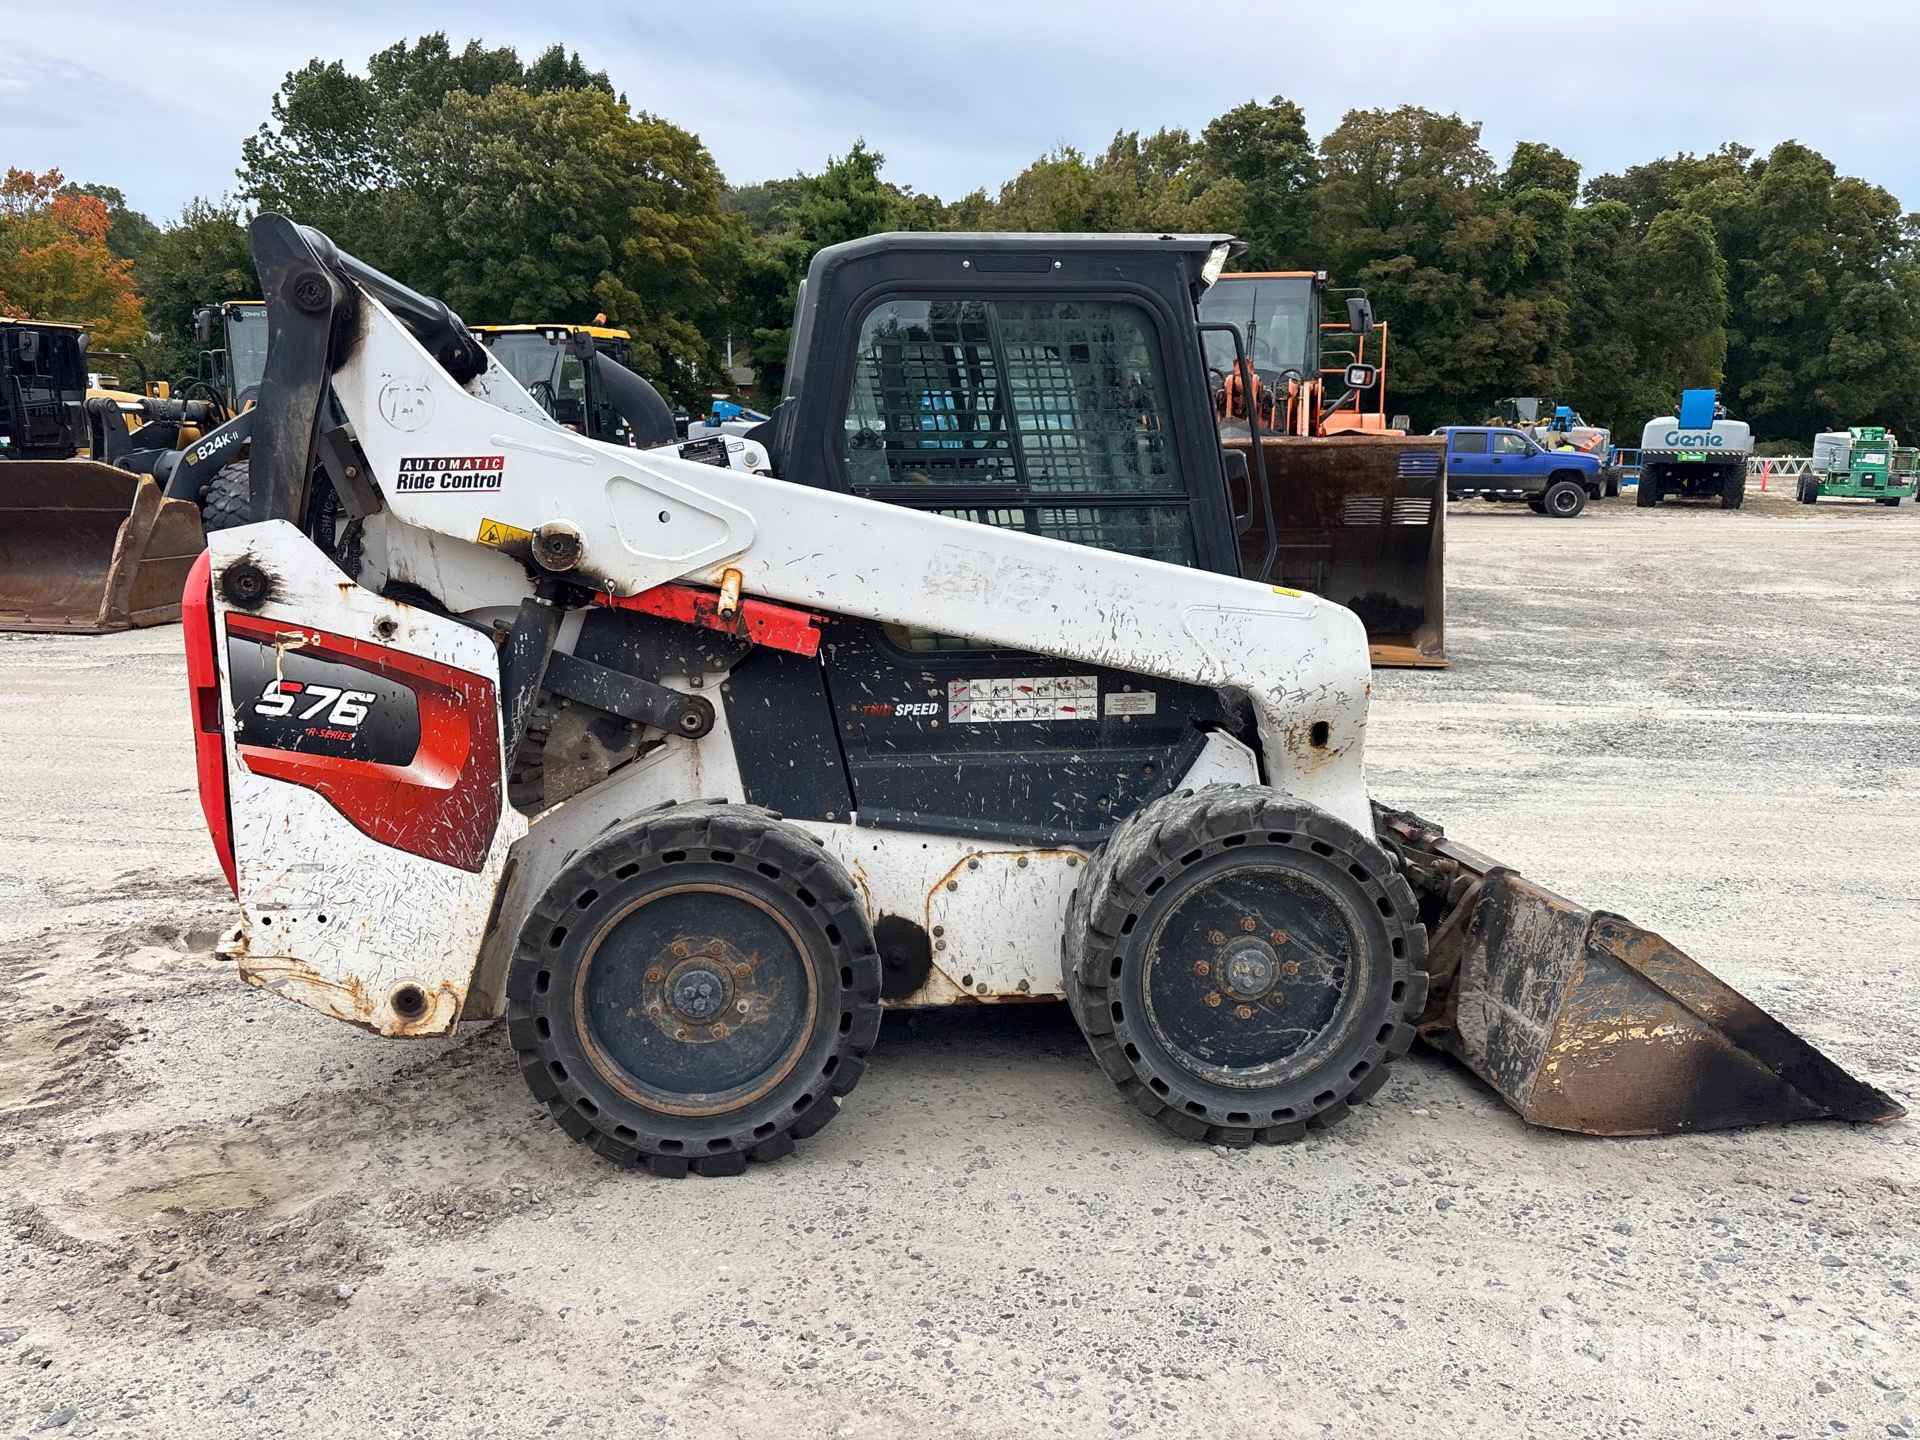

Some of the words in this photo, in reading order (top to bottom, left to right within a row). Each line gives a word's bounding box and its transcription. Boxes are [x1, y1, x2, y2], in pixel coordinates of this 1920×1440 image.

[1664, 430, 1723, 447] Genie
[403, 458, 501, 470] AUTOMATIC
[396, 473, 435, 490] Ride
[440, 472, 502, 489] Control
[254, 679, 377, 726] S76
[894, 702, 939, 717] SPEED
[307, 727, 354, 742] R-SERIES
